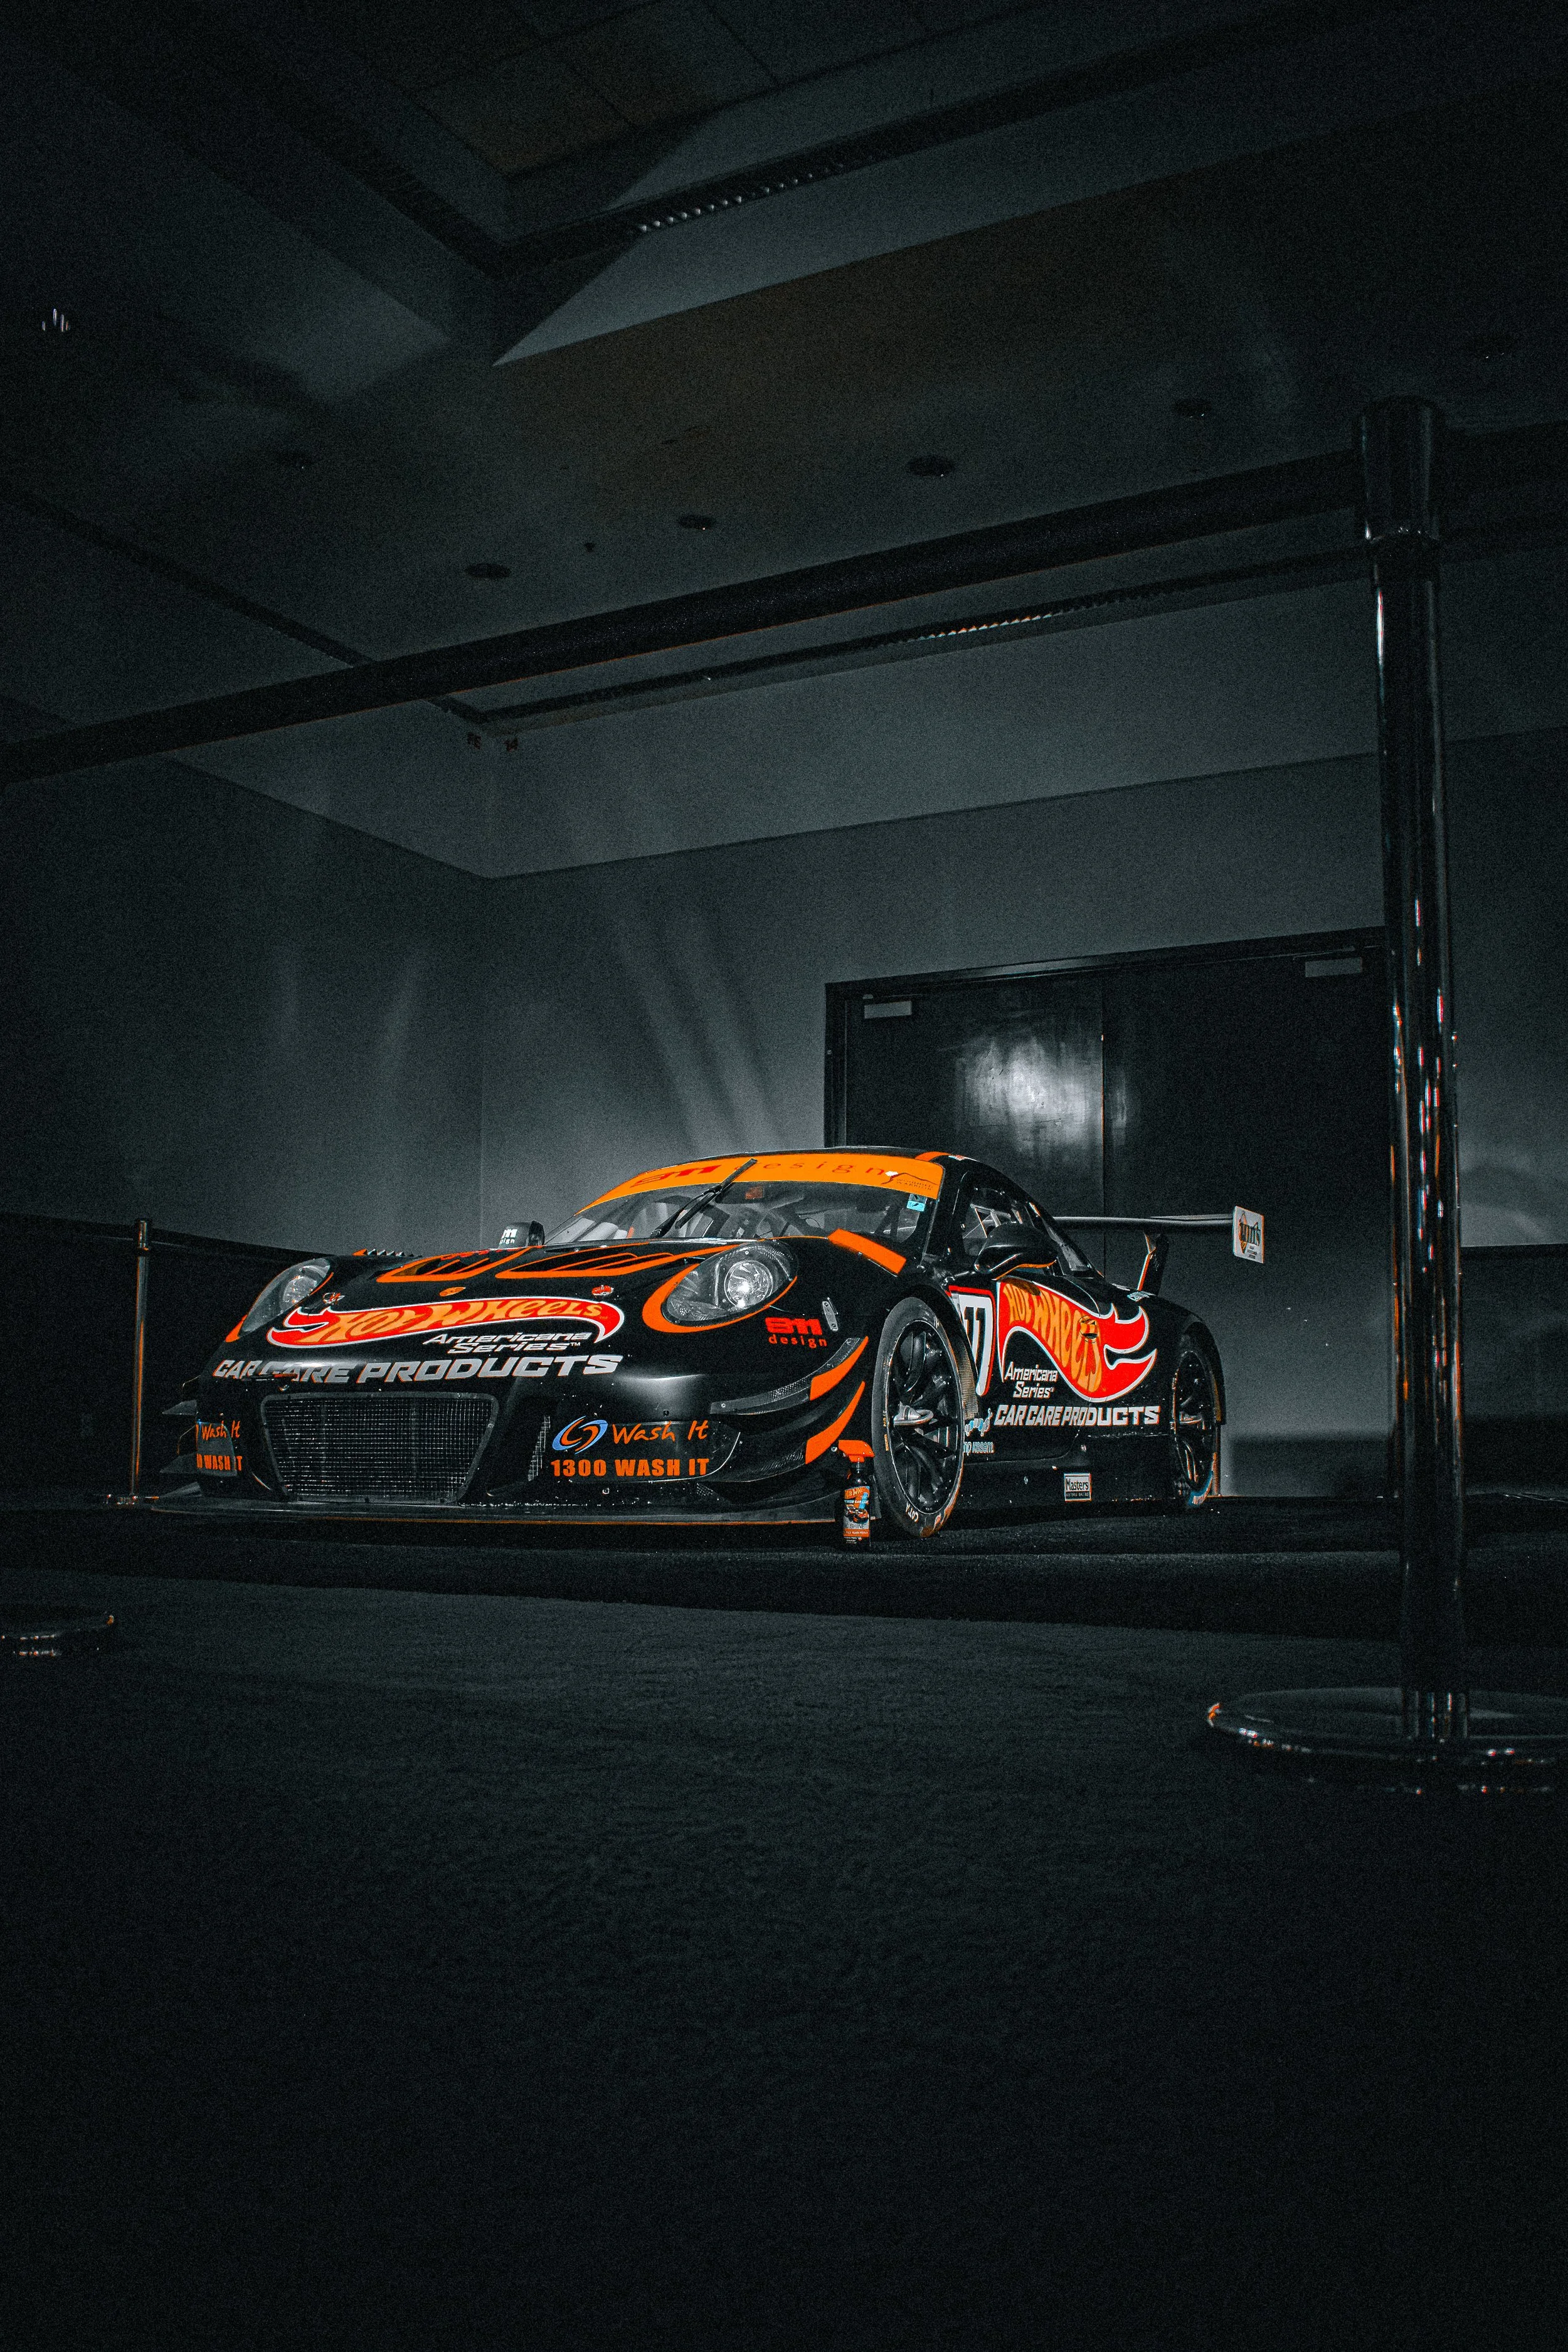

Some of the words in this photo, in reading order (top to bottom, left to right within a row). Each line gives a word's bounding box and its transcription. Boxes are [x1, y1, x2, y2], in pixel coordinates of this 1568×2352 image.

[734, 1161, 885, 1175] esign
[422, 1332, 592, 1345] Americana
[768, 1334, 827, 1348] design
[213, 1360, 262, 1379] CAR
[356, 1354, 623, 1384] PRODUCTS
[1004, 1361, 1059, 1382] Americana
[993, 1404, 1025, 1427] CAR
[1025, 1405, 1064, 1427] CARE
[1060, 1405, 1162, 1427] PRODUCTS
[202, 1420, 227, 1441] Wash
[231, 1420, 241, 1438] It
[612, 1420, 676, 1444] Wash
[687, 1419, 709, 1441] It
[204, 1454, 231, 1471] WASH
[550, 1459, 607, 1477] 1300
[614, 1459, 681, 1477] WASH
[689, 1458, 710, 1476] IT
[1065, 1478, 1089, 1491] Masters
